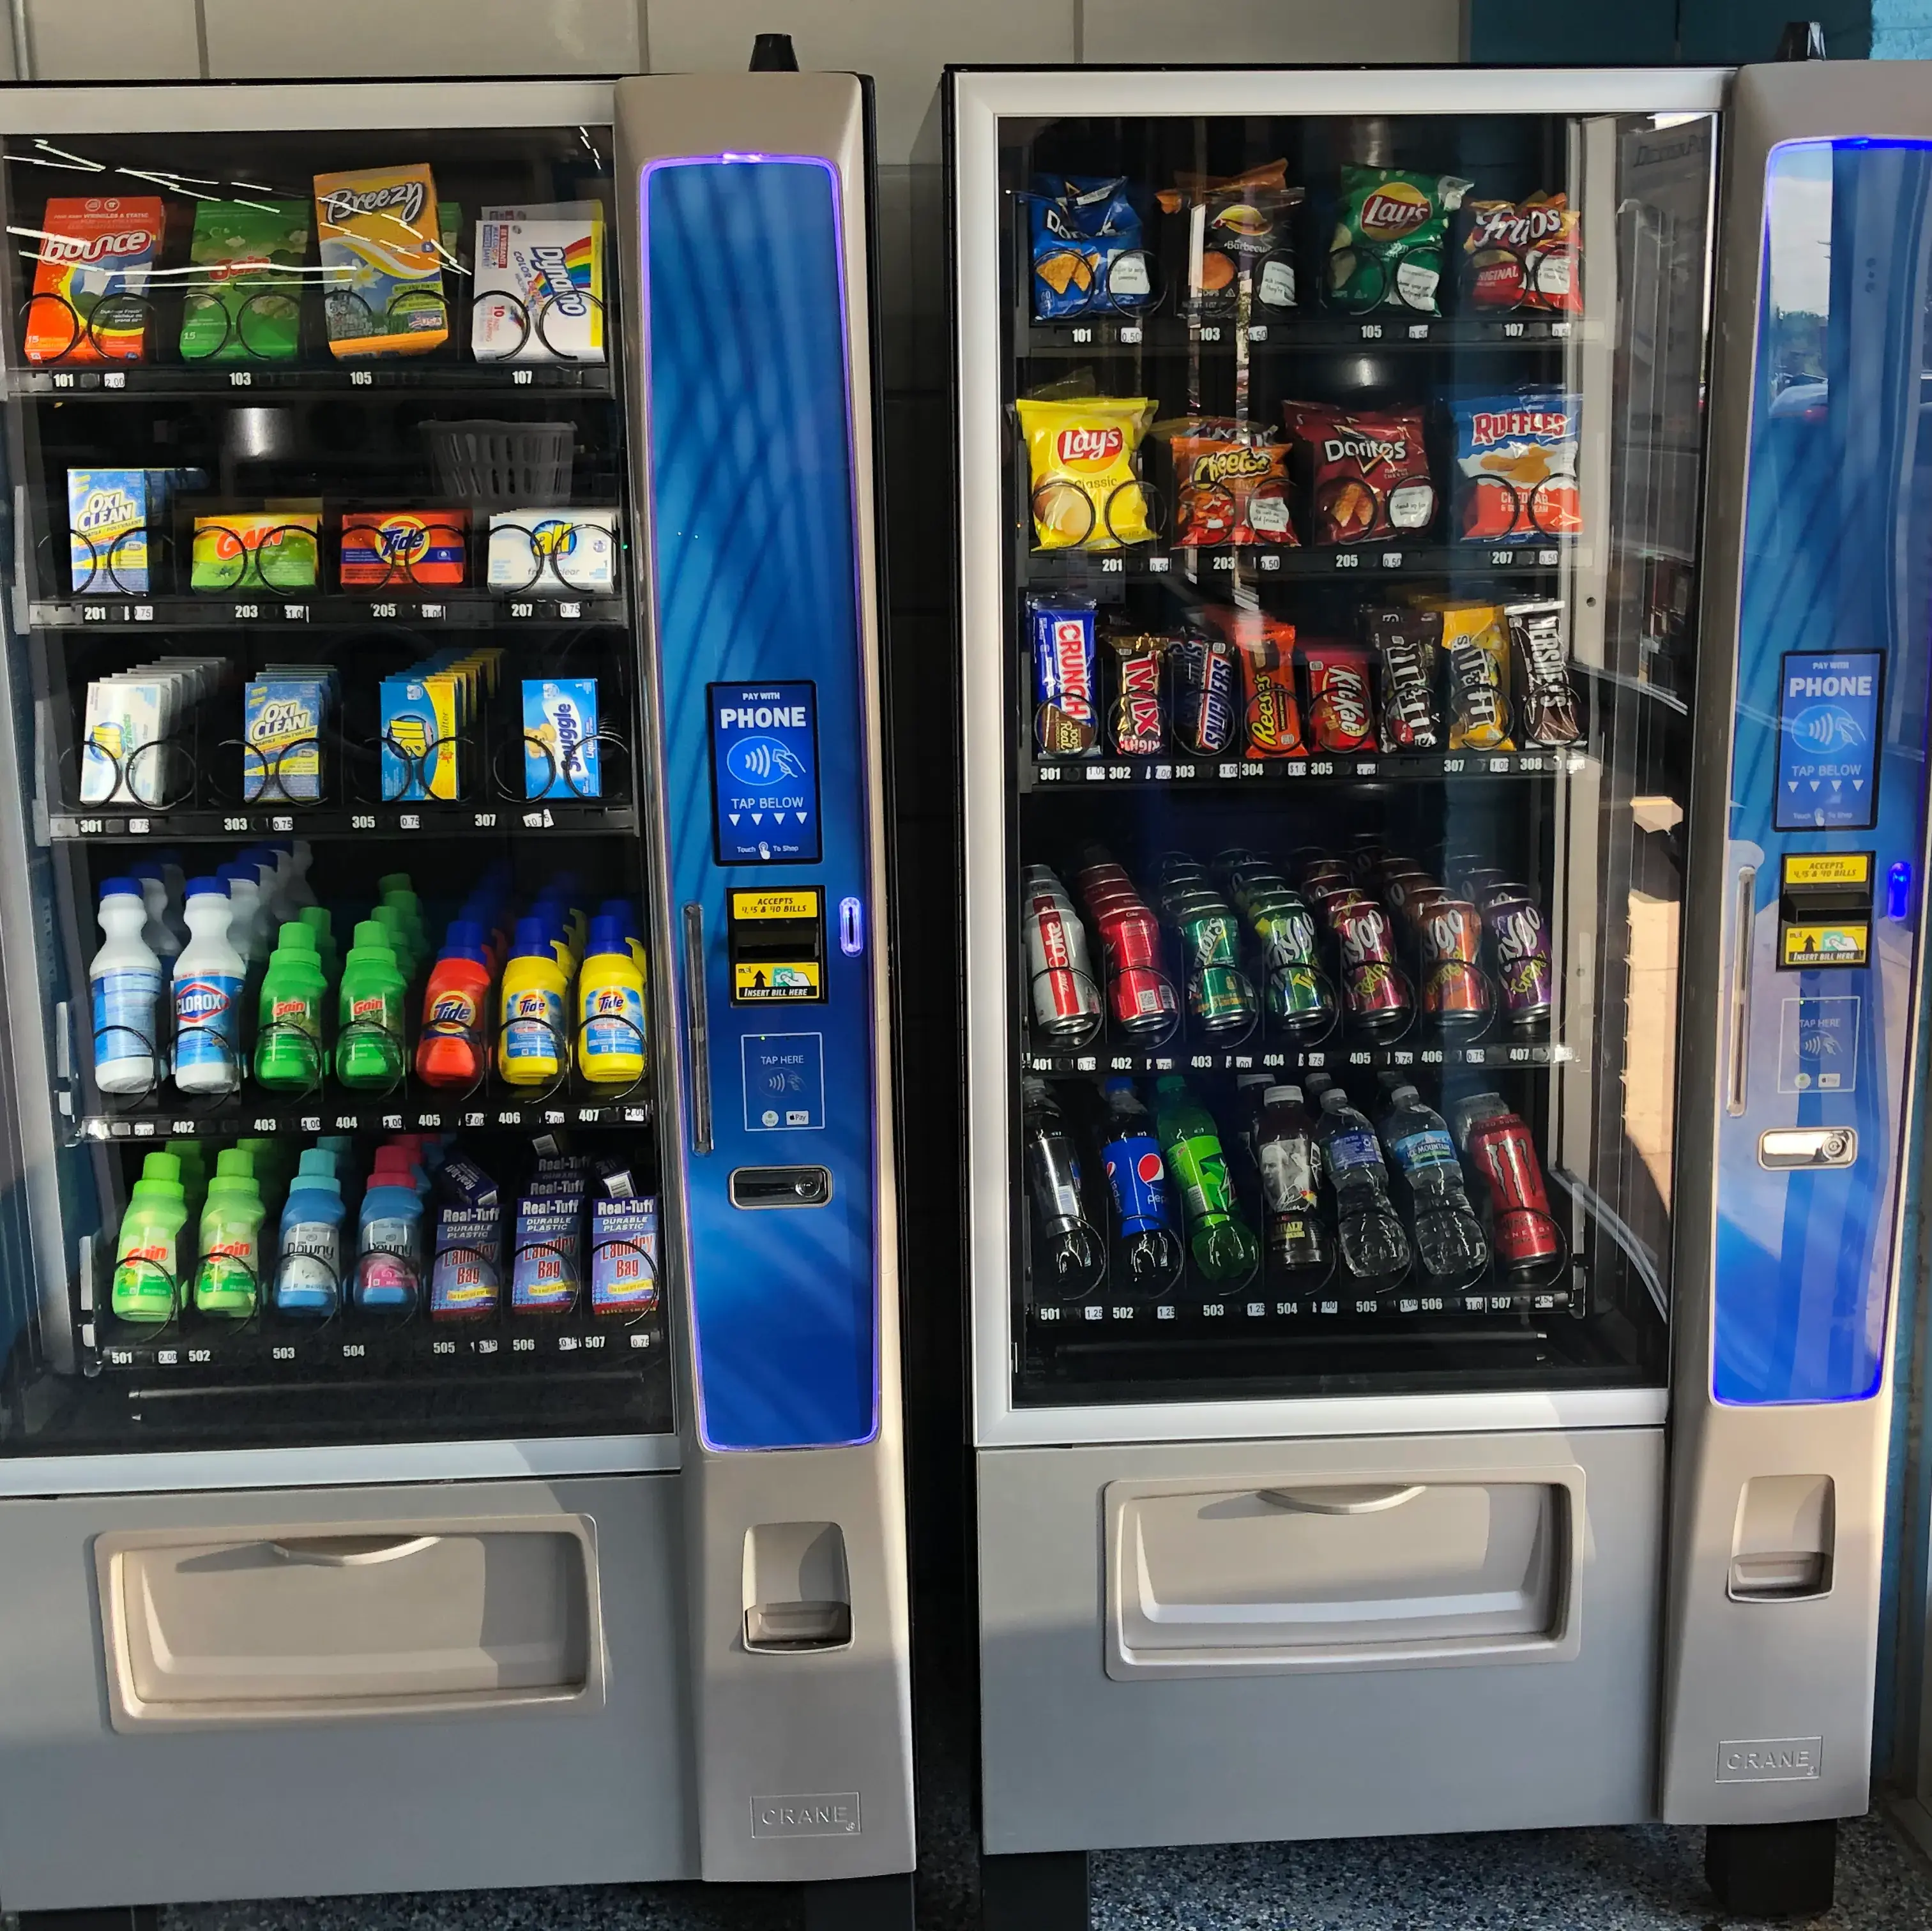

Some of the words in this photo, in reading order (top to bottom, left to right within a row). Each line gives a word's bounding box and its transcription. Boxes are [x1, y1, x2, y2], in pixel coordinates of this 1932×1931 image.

[323, 182, 424, 223] Breezy
[1364, 196, 1428, 230] Lay's
[43, 231, 148, 262] bounce
[513, 251, 531, 279] COLOR
[529, 246, 588, 317] Dynamo
[494, 305, 505, 317] 10
[422, 317, 442, 326] USA
[1072, 328, 1092, 343] 101
[1200, 328, 1221, 341] 103
[1362, 326, 1382, 339] 105
[1505, 324, 1525, 337] 107
[1122, 333, 1140, 343] 0.50
[54, 374, 74, 387] 101
[229, 373, 251, 386] 103
[350, 372, 372, 385] 105
[513, 371, 533, 384] 107
[1473, 413, 1567, 445] RUFFLES
[1062, 427, 1120, 460] Lay's
[1325, 439, 1406, 462] Doritos
[89, 492, 121, 515] OXI
[78, 503, 133, 532] CLEAN
[215, 527, 285, 560] Gain
[381, 528, 425, 557] Tide
[533, 522, 574, 557] all
[1213, 557, 1236, 571] 203
[1261, 558, 1278, 569] 0.50
[1336, 555, 1358, 568] 205
[1492, 552, 1513, 565] 207
[1102, 559, 1123, 572] 201
[85, 607, 107, 621] 201
[235, 606, 257, 619] 203
[373, 604, 396, 617] 205
[512, 604, 533, 617] 207
[561, 605, 581, 614] 0.75
[1058, 623, 1088, 718] CRUNCH
[1125, 651, 1159, 734] TWIX
[1789, 676, 1872, 697] PHONE
[743, 692, 759, 700] PAY
[759, 692, 780, 700] WITH
[1203, 658, 1233, 750] SNICKERS
[1251, 674, 1275, 746] Reese's
[264, 702, 297, 724] OXI
[720, 706, 807, 729] PHONE
[252, 713, 308, 741] CLEAN
[553, 703, 582, 772] snuggle
[1241, 764, 1263, 776] 304
[1311, 762, 1333, 775] 305
[1443, 759, 1464, 771] 307
[1520, 758, 1542, 770] 308
[1791, 766, 1814, 776] TAP
[1818, 764, 1862, 776] BELOW
[1040, 768, 1061, 780] 301
[1109, 766, 1131, 779] 302
[731, 798, 756, 809] TAP
[759, 797, 804, 808] BELOW
[80, 819, 102, 833] 301
[131, 821, 149, 830] 0.75
[224, 817, 248, 831] 303
[273, 821, 293, 830] 0.75
[352, 816, 376, 829] 305
[402, 817, 420, 826] 0.75
[475, 814, 496, 827] 307
[782, 845, 799, 854] Shop
[757, 897, 793, 905] ACCEPTS
[1793, 952, 1817, 962] INSERT
[1819, 952, 1834, 960] BILL
[1836, 951, 1855, 960] HERE
[743, 988, 769, 997] INSERT
[771, 988, 787, 996] BILL
[789, 987, 808, 996] HERE
[176, 994, 222, 1015] CLOROX
[272, 999, 306, 1017] Gain
[352, 998, 383, 1015] Gain
[519, 998, 546, 1018] Tide
[598, 996, 624, 1015] Tide
[434, 1001, 470, 1022] Tide
[1799, 1020, 1816, 1028] TAP
[1818, 1019, 1840, 1027] HERE
[760, 1056, 778, 1064] TAP
[780, 1055, 804, 1064] HERE
[1263, 1054, 1284, 1066] 404
[1350, 1052, 1371, 1064] 405
[1421, 1050, 1443, 1063] 406
[1510, 1049, 1529, 1061] 407
[1032, 1058, 1052, 1071] 401
[1111, 1057, 1132, 1070] 402
[1190, 1056, 1212, 1068] 403
[418, 1114, 441, 1127] 405
[499, 1112, 521, 1124] 406
[579, 1109, 600, 1123] 407
[174, 1121, 195, 1134] 402
[255, 1119, 277, 1132] 403
[336, 1117, 358, 1129] 404
[531, 1179, 584, 1196] Real-Tuff
[522, 1199, 579, 1216] Real-Tuff
[598, 1198, 653, 1215] Real-Tuff
[443, 1208, 500, 1224] Real-Tuff
[526, 1216, 572, 1225] DURABLE
[602, 1216, 648, 1225] DURABLE
[446, 1224, 493, 1234] DURABLE
[527, 1223, 568, 1232] PLASTIC
[603, 1222, 644, 1232] PLASTIC
[447, 1231, 488, 1239] PLASTIC
[209, 1241, 252, 1263] Gain
[524, 1235, 576, 1261] Laundry
[600, 1234, 653, 1261] Laundry
[124, 1245, 169, 1268] Gain
[443, 1243, 496, 1268] Laundry
[456, 1266, 480, 1285] Bag
[538, 1260, 560, 1278] Bag
[615, 1260, 639, 1278] Bag
[1277, 1302, 1298, 1315] 504
[1356, 1301, 1377, 1313] 505
[1421, 1298, 1443, 1310] 506
[1491, 1297, 1511, 1309] 507
[1040, 1308, 1060, 1321] 501
[1087, 1308, 1103, 1318] 1.25
[1113, 1306, 1134, 1319] 502
[1159, 1308, 1176, 1317] 1.25
[1203, 1305, 1224, 1317] 503
[1249, 1305, 1265, 1315] 1.25
[433, 1342, 455, 1354] 505
[513, 1339, 535, 1351] 506
[585, 1336, 606, 1348] 507
[188, 1350, 211, 1363] 502
[273, 1347, 296, 1359] 503
[343, 1345, 365, 1357] 504
[112, 1351, 133, 1365] 501
[1727, 1751, 1809, 1771] CRANE
[761, 1806, 848, 1825] CRANE
